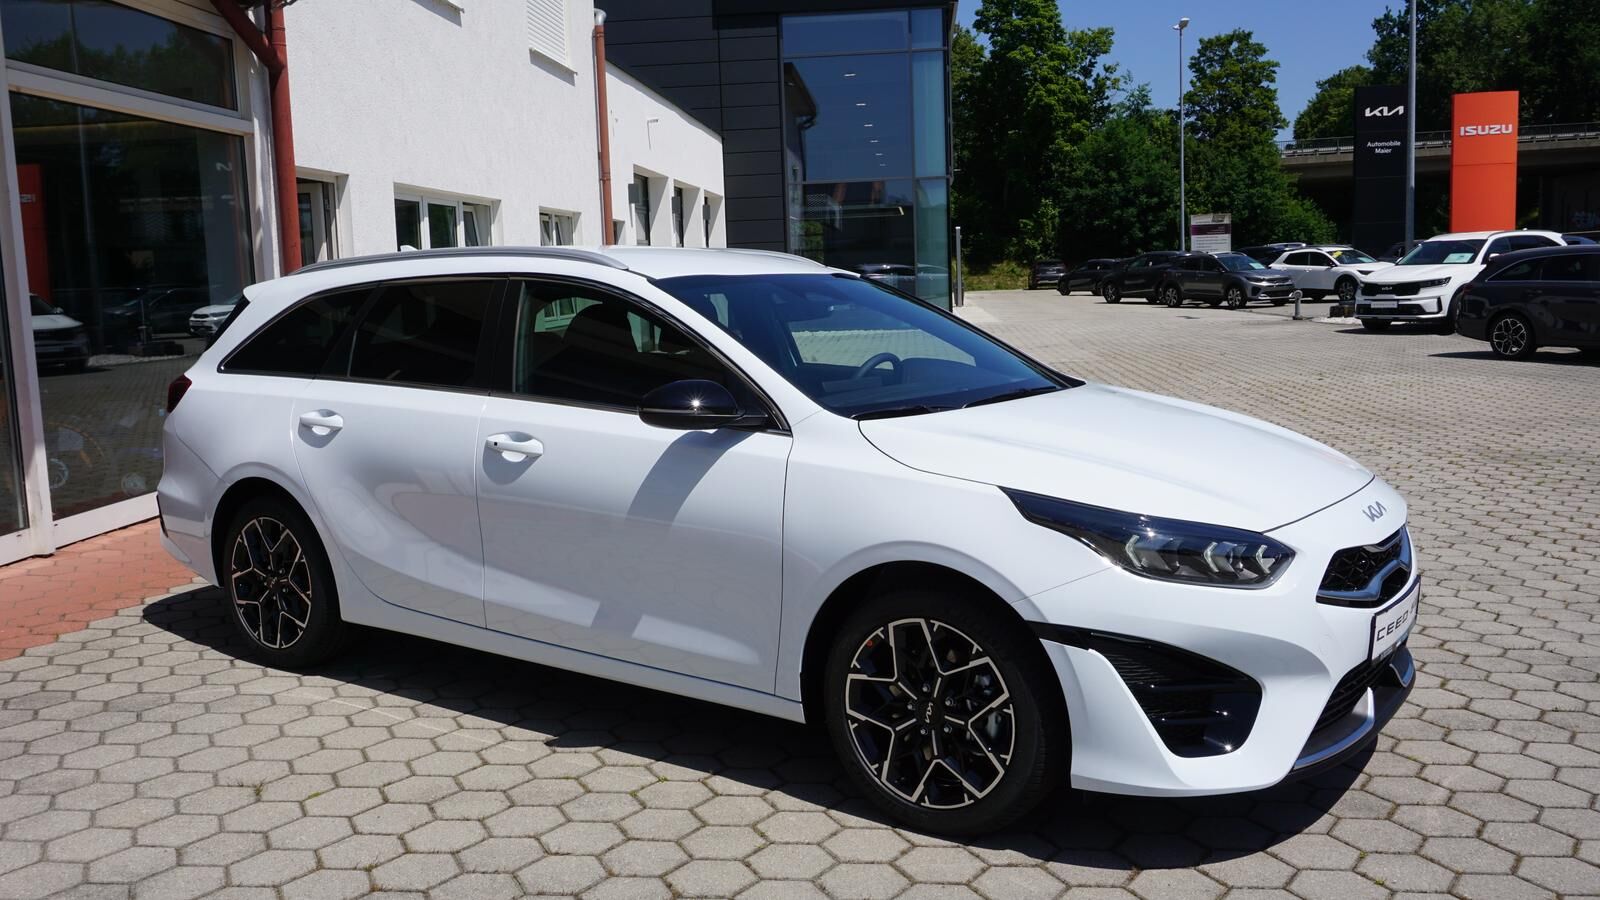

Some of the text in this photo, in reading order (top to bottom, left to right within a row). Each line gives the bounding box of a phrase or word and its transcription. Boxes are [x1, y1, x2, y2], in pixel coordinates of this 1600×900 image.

[1365, 105, 1404, 117] KIA
[1460, 124, 1513, 136] ISUZU
[1362, 501, 1387, 522] KIA
[1376, 610, 1409, 641] CEED
